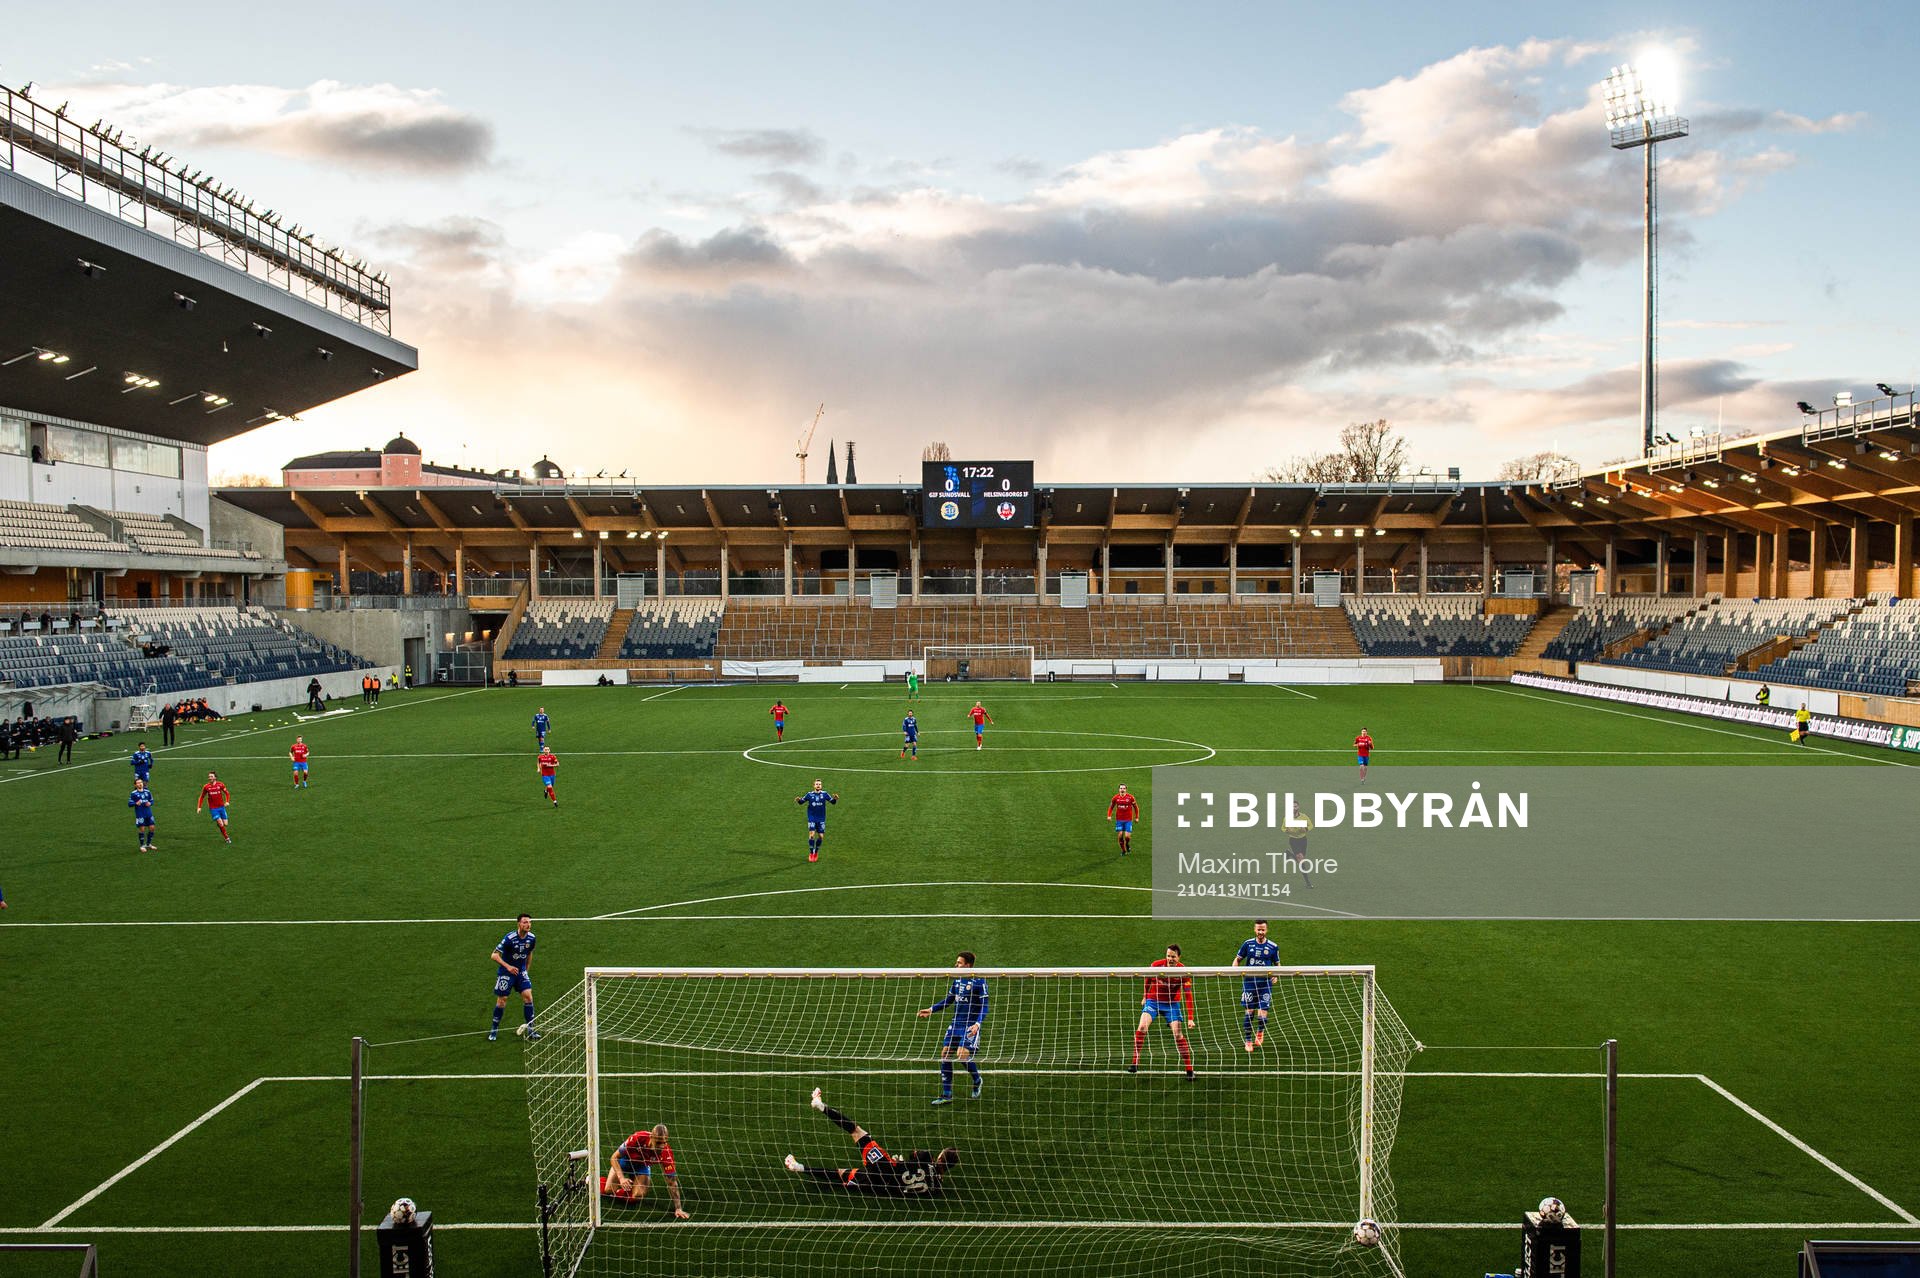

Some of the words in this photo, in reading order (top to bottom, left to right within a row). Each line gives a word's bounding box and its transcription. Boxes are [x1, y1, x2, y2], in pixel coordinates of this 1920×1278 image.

[963, 467, 994, 478] 17:22
[945, 479, 954, 491] 0
[1002, 479, 1010, 491] 0
